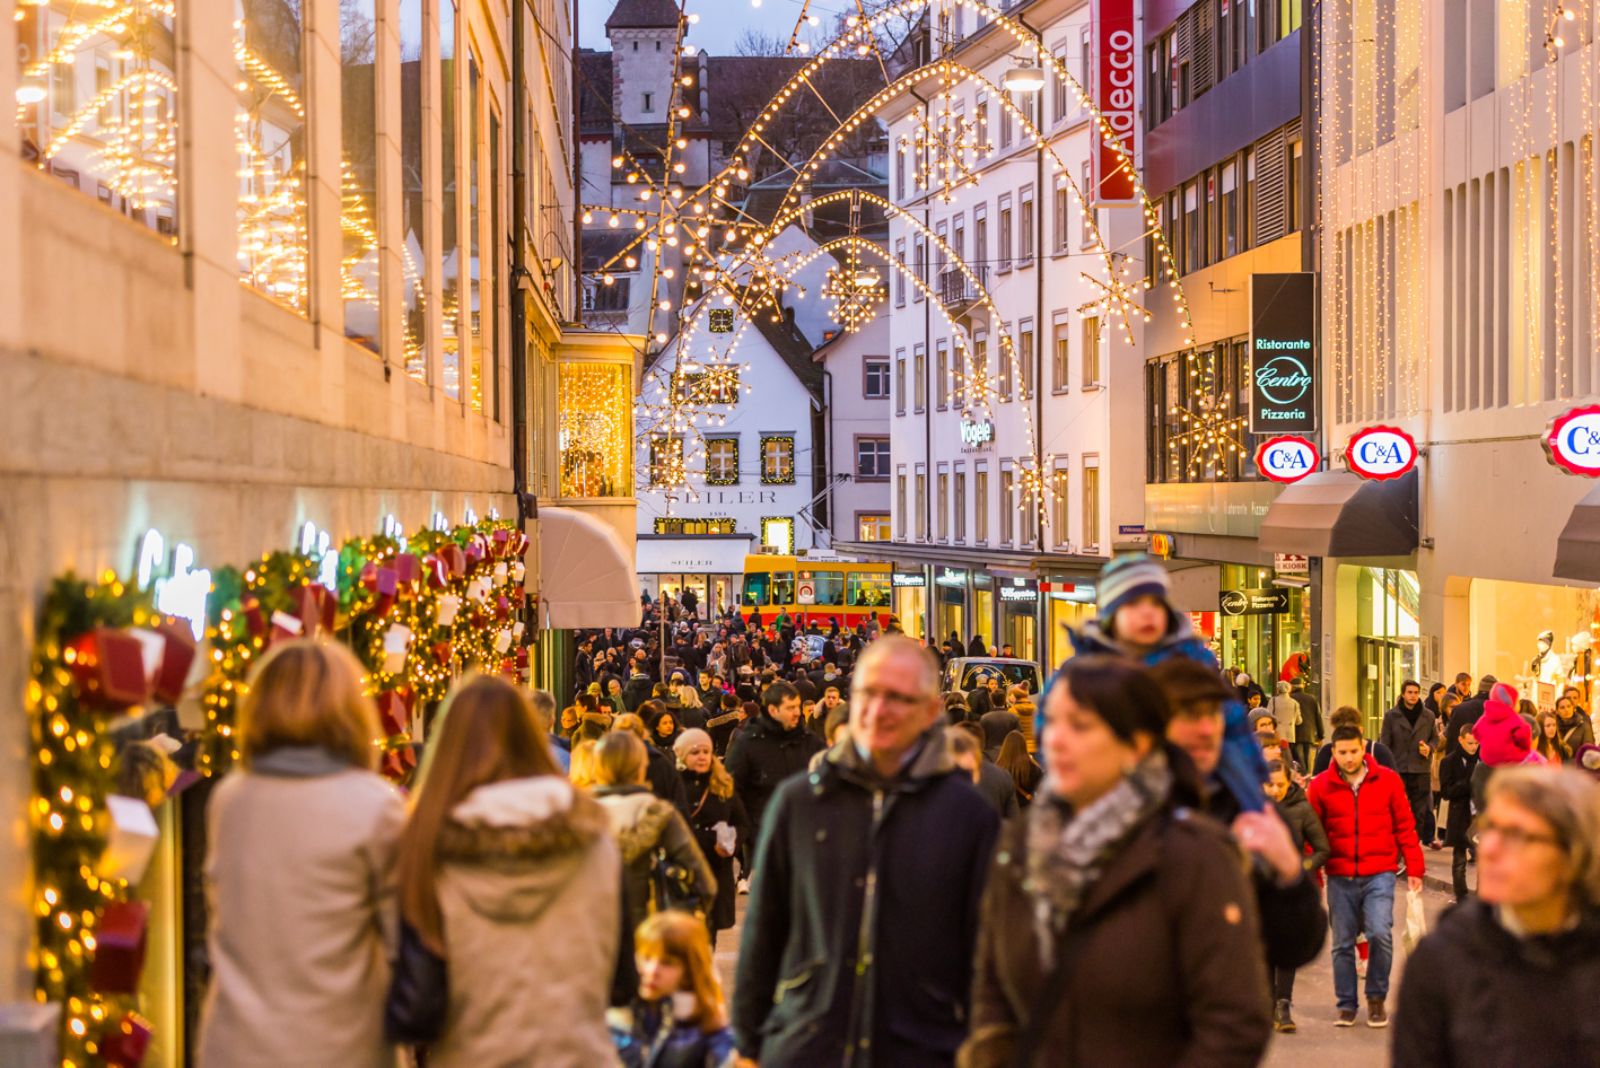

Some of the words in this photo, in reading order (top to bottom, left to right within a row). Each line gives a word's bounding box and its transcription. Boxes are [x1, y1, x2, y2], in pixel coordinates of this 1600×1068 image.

[1102, 29, 1133, 156] Adecco
[1256, 338, 1311, 350] Ristorante
[1255, 367, 1312, 387] Centro
[1261, 408, 1306, 420] Pizzeria
[1567, 426, 1600, 456] C&
[1269, 449, 1308, 470] C&A
[1360, 441, 1404, 464] C&A
[664, 491, 777, 504] SEILER
